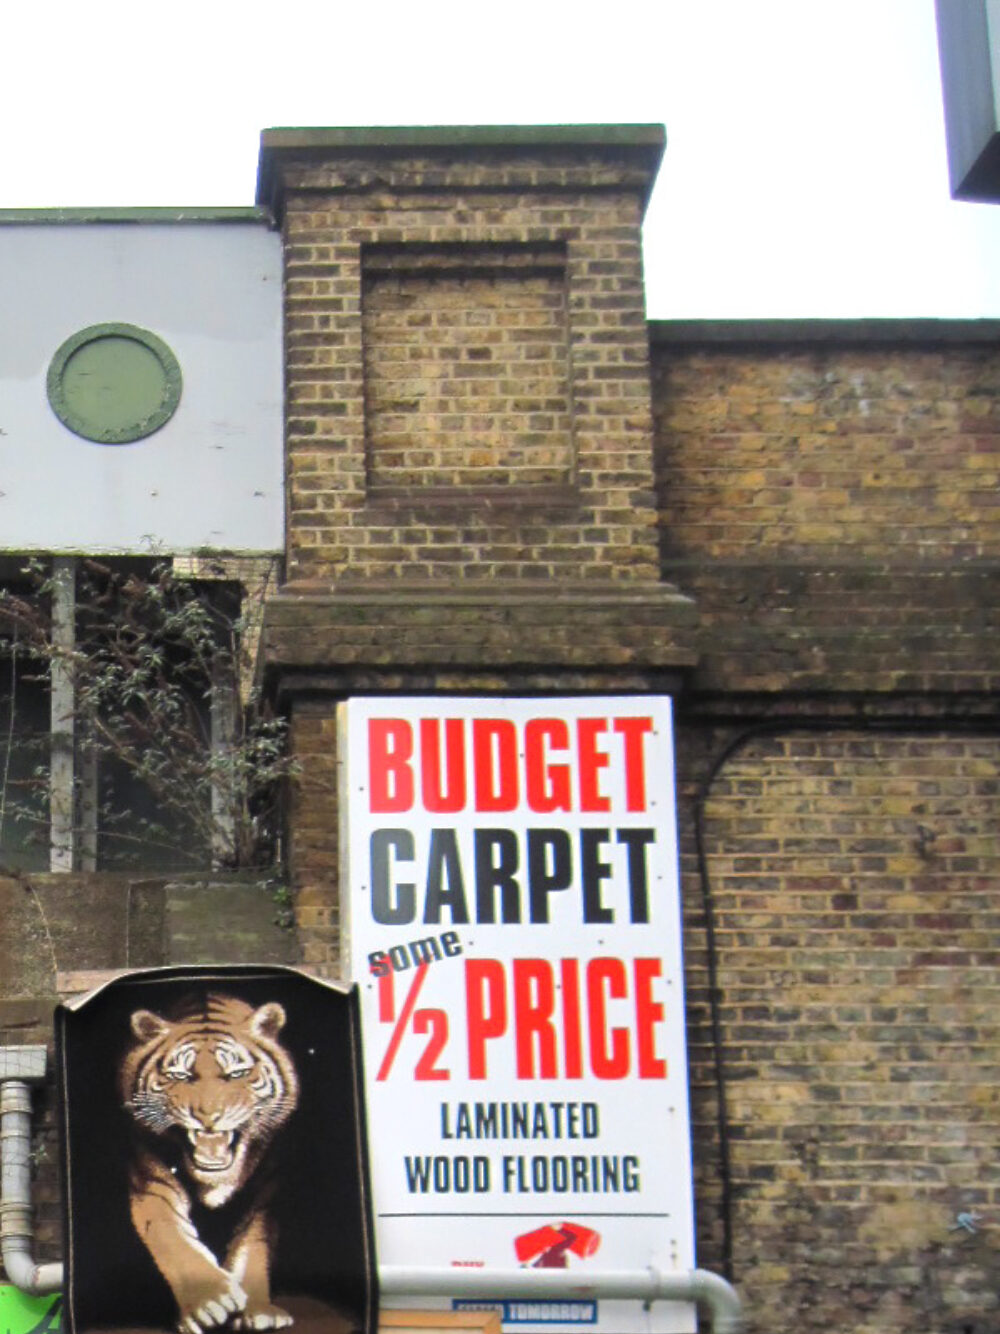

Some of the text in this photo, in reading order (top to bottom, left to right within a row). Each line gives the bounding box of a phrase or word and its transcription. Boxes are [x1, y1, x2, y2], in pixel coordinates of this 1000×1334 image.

[367, 716, 655, 815] BUDGET
[369, 827, 655, 926] CARPET
[368, 931, 462, 978] some
[464, 956, 668, 1083] PRICE
[440, 1101, 600, 1141] LAMINATED
[404, 1155, 641, 1194] WOOD FLOORING
[509, 1303, 595, 1321] TOMORROW
